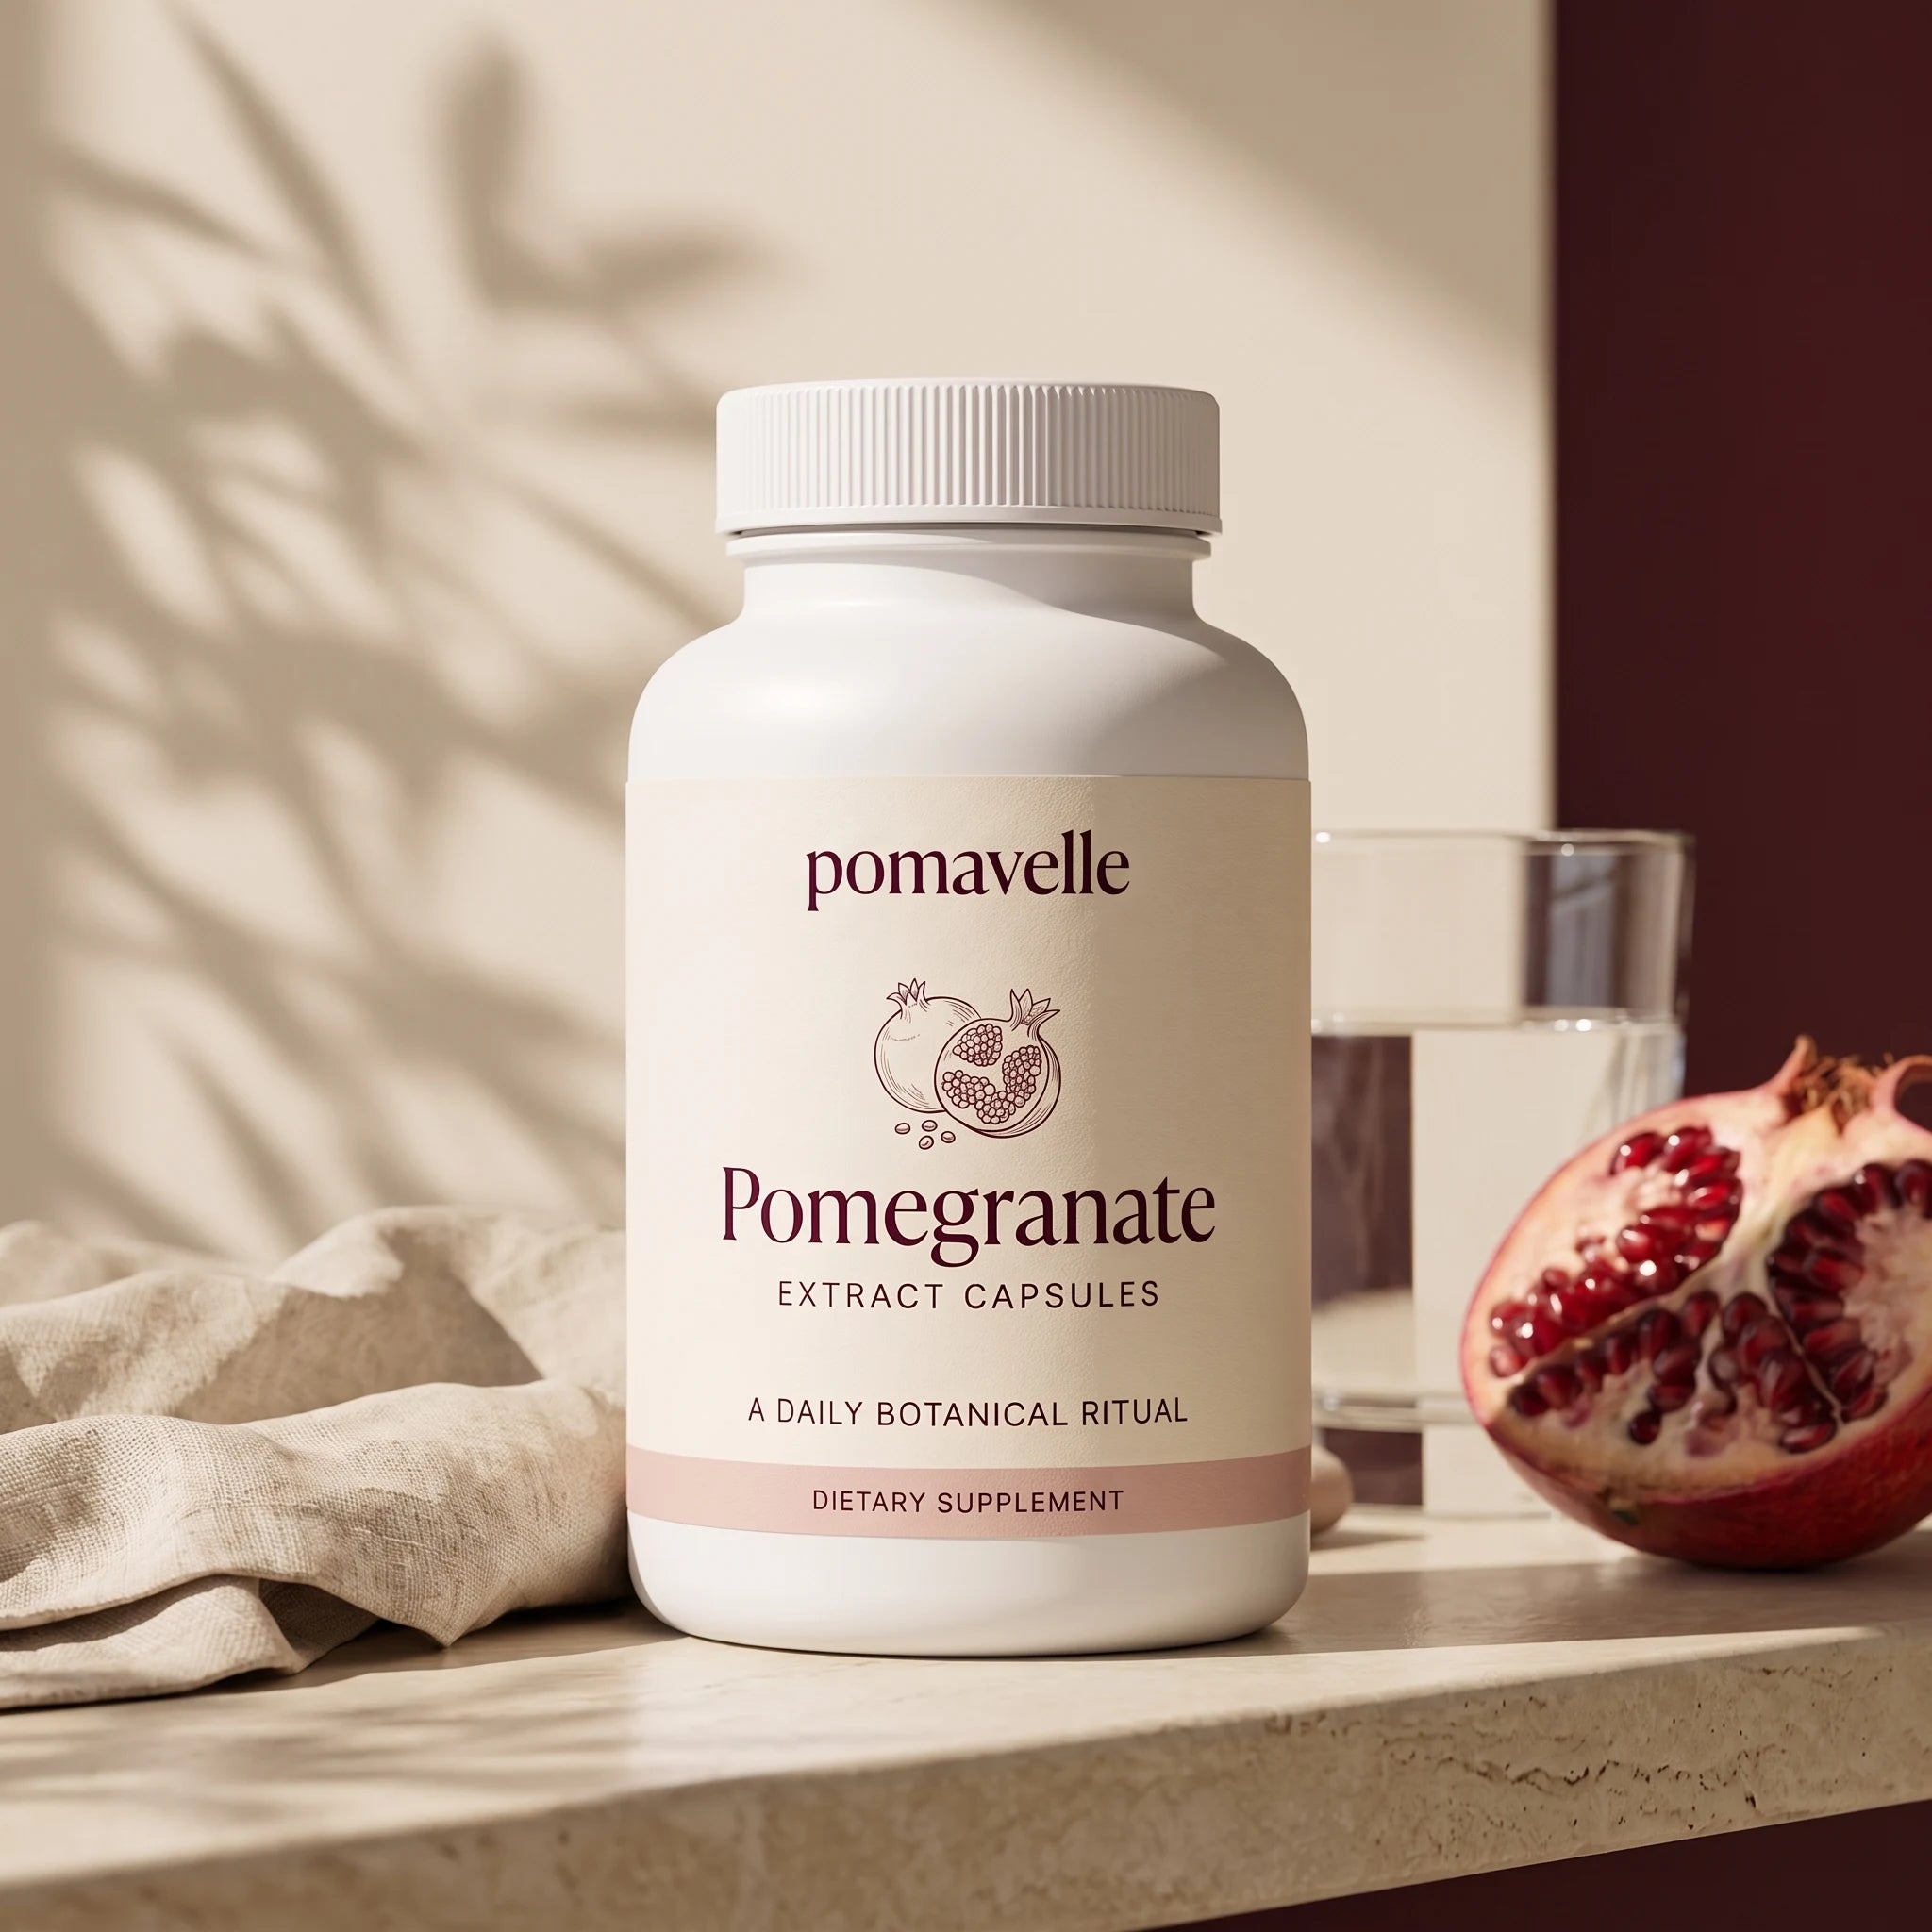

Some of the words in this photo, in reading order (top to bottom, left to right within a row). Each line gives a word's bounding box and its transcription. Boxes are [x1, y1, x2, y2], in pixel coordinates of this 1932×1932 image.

[806, 829, 1130, 912] pomavelle
[722, 1166, 1216, 1268] Pomegranate
[778, 1280, 944, 1309] EXTRACT
[964, 1280, 1159, 1310] CAPSULES
[747, 1396, 765, 1423] A
[777, 1397, 863, 1425] DAILY
[877, 1400, 1069, 1427] BOTANICAL
[1082, 1396, 1189, 1426] RITUAL
[812, 1489, 926, 1513] DIETARY
[937, 1490, 1124, 1514] SUPPLEMENT
